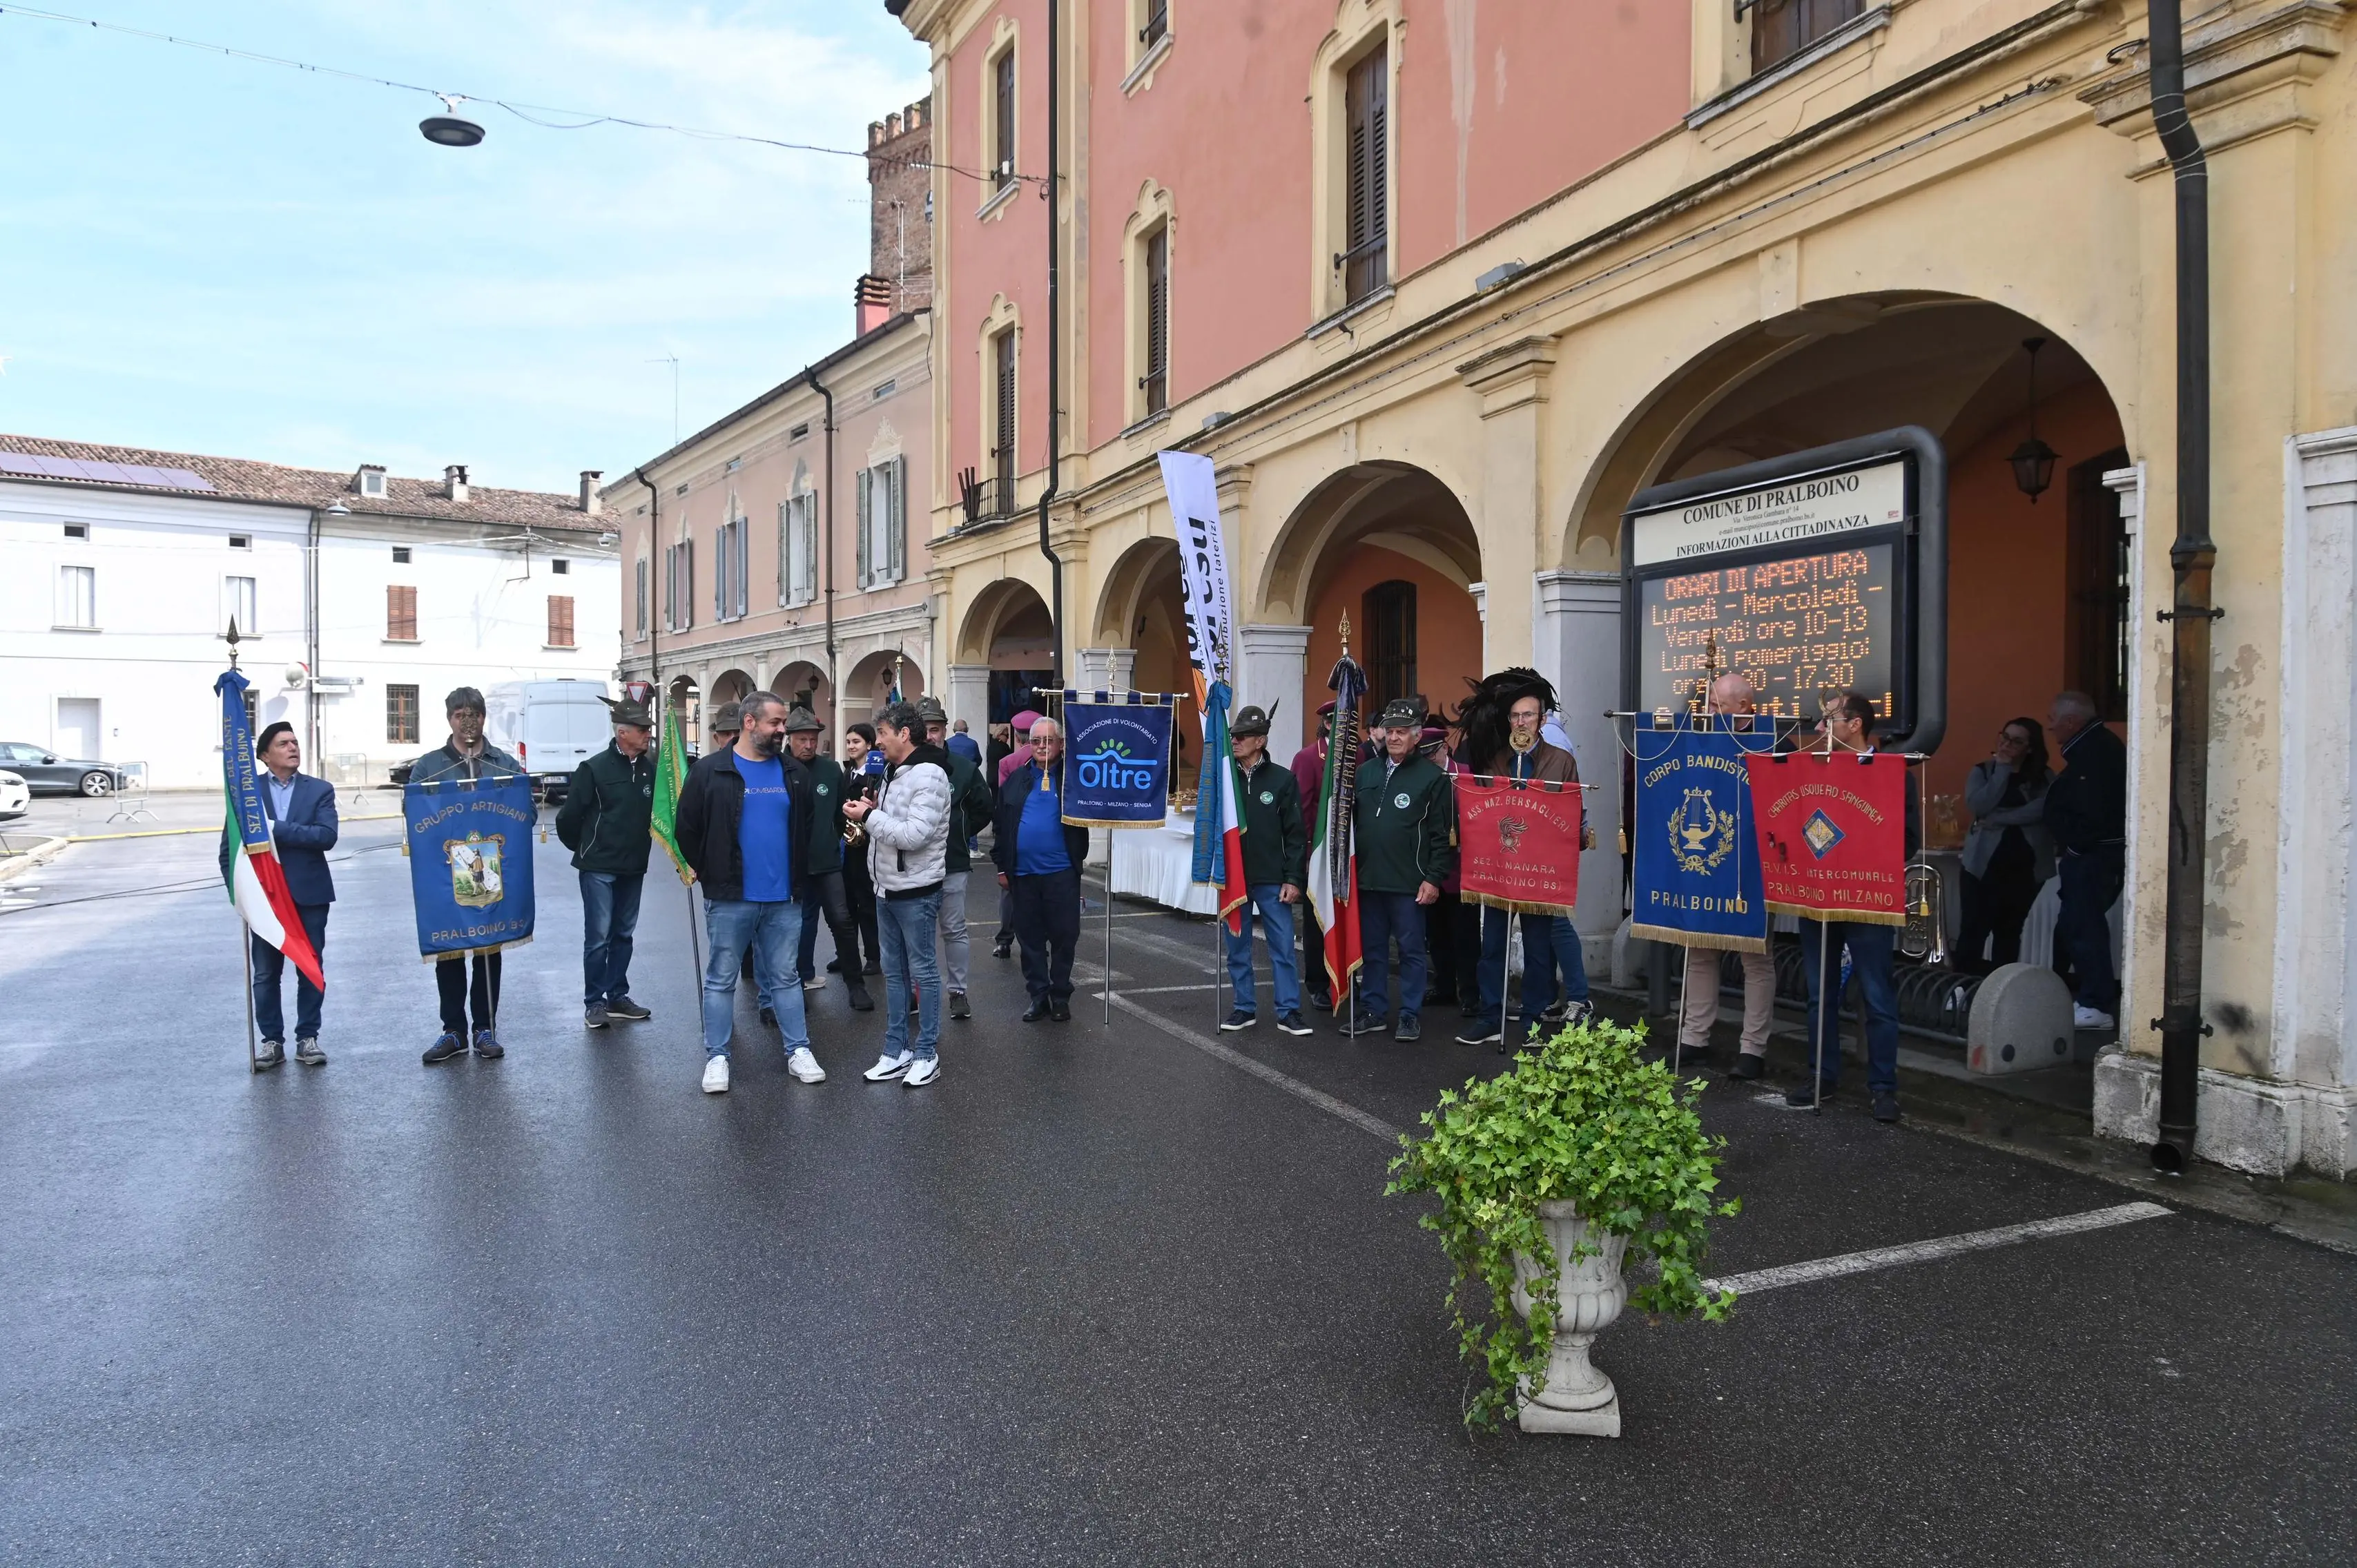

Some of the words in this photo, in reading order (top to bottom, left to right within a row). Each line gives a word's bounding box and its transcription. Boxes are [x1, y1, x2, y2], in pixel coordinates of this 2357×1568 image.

[1683, 499, 1743, 525] COMUNE
[1746, 496, 1761, 512] DI
[1766, 474, 1859, 509] PRALBOINO
[1718, 527, 1733, 536] e-mail
[1743, 513, 1763, 522] Veronica
[1209, 519, 1221, 572] laterizi
[1676, 535, 1749, 557] INFORMAZIONI
[1752, 527, 1780, 546] ALLA
[1782, 514, 1870, 539] CITTADINANZA
[1665, 572, 1720, 601] ORARI
[1725, 568, 1747, 592] DI
[1754, 550, 1868, 588] APERTURA
[1652, 597, 1718, 626] Lunedì
[1743, 579, 1859, 616] Mercoledì
[1756, 620, 1797, 640] ore
[1804, 605, 1868, 636] 10-13
[1794, 662, 1854, 690] 17.30
[224, 715, 232, 751] FANTE
[1076, 718, 1112, 743] ASSOCIAZIONE
[1120, 719, 1158, 745] VOLONTARIATO
[1332, 708, 1349, 779] NAZIONALE
[226, 756, 235, 777] DEL
[237, 728, 255, 791] PRALBOINO
[1644, 758, 1680, 788] CORPO
[1078, 762, 1152, 790] Oltre
[244, 796, 258, 807] DI
[1467, 804, 1484, 820] ASS.
[1484, 795, 1503, 808] NAZ.
[1506, 795, 1571, 833] BERSAGLIERI
[1767, 788, 1800, 819] CHARITAS
[1800, 784, 1825, 797] USQUE
[1825, 784, 1839, 798] AD
[1839, 790, 1884, 826] SANGUINEM
[414, 802, 464, 834] GRUPPO
[471, 801, 527, 822] ARTIGIANI
[1473, 856, 1493, 867] SEZ.
[1504, 860, 1556, 875] MANARA
[1763, 861, 1801, 876] A.V.I.S.
[1807, 867, 1895, 883] INTERCOMUNALE
[1472, 870, 1536, 888] PRALBOINO
[1540, 880, 1562, 891] (BS)
[1767, 882, 1825, 902] PRALBOINO
[1833, 889, 1893, 907] MILZANO
[1651, 890, 1748, 915] PRALBOINO
[431, 921, 505, 942] PRALBOINO
